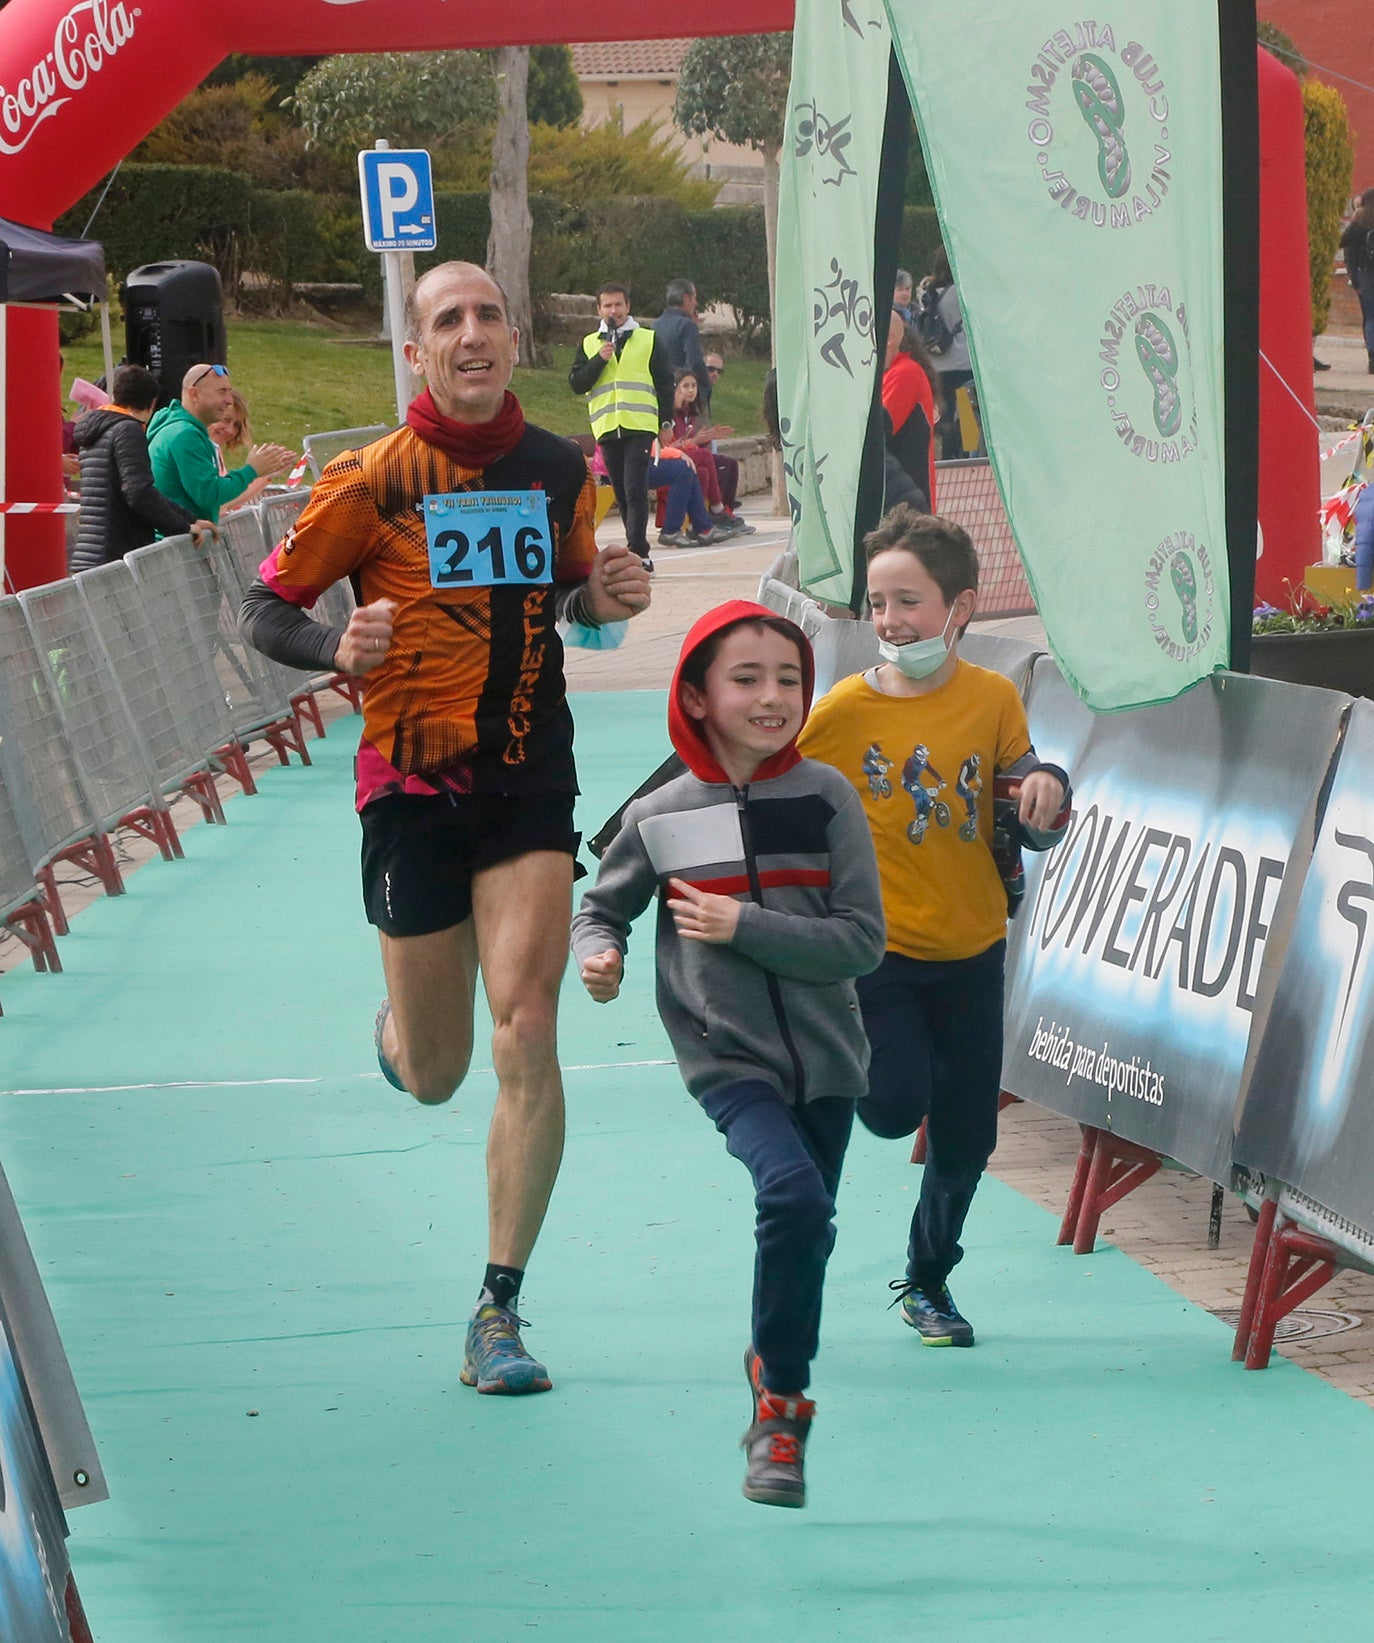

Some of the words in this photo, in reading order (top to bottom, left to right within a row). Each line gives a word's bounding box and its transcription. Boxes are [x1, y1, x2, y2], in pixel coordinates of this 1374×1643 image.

[0, 0, 134, 154] oca-Cola
[377, 162, 418, 238] P
[434, 527, 546, 582] 216
[1028, 1016, 1074, 1071] bebida
[1066, 1044, 1096, 1086] para
[1095, 1041, 1165, 1107] deportistas
